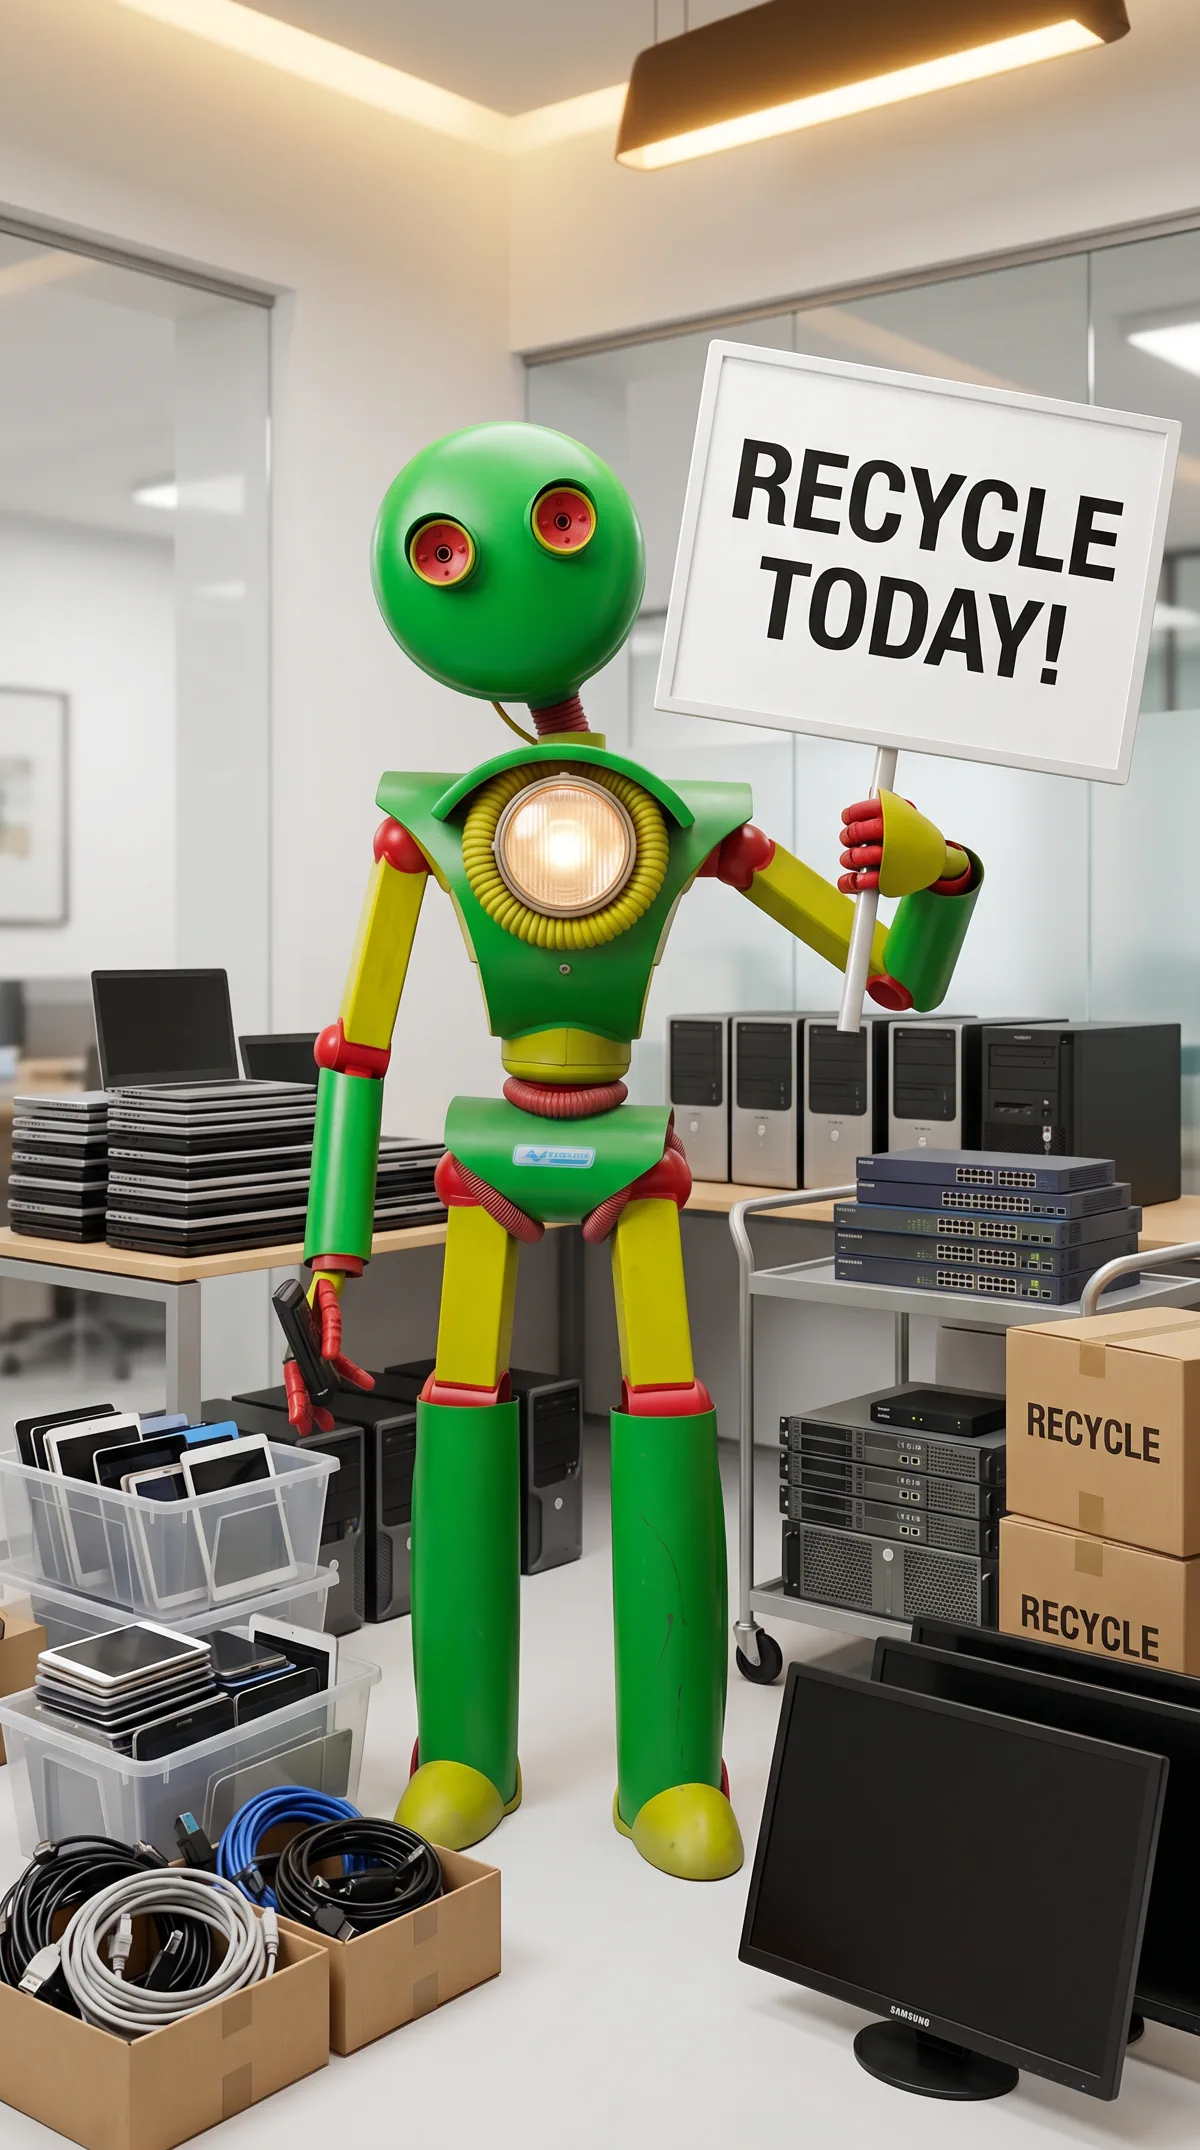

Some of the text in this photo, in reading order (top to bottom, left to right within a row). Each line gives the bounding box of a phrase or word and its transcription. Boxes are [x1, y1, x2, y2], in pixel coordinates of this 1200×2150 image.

[732, 439, 1124, 582] RECYCLE
[760, 556, 1068, 686] TODAY!
[1027, 1402, 1161, 1464] RECYCLE
[1021, 1594, 1159, 1663] RECYCLE
[890, 2005, 930, 2027] SAMSUNG
